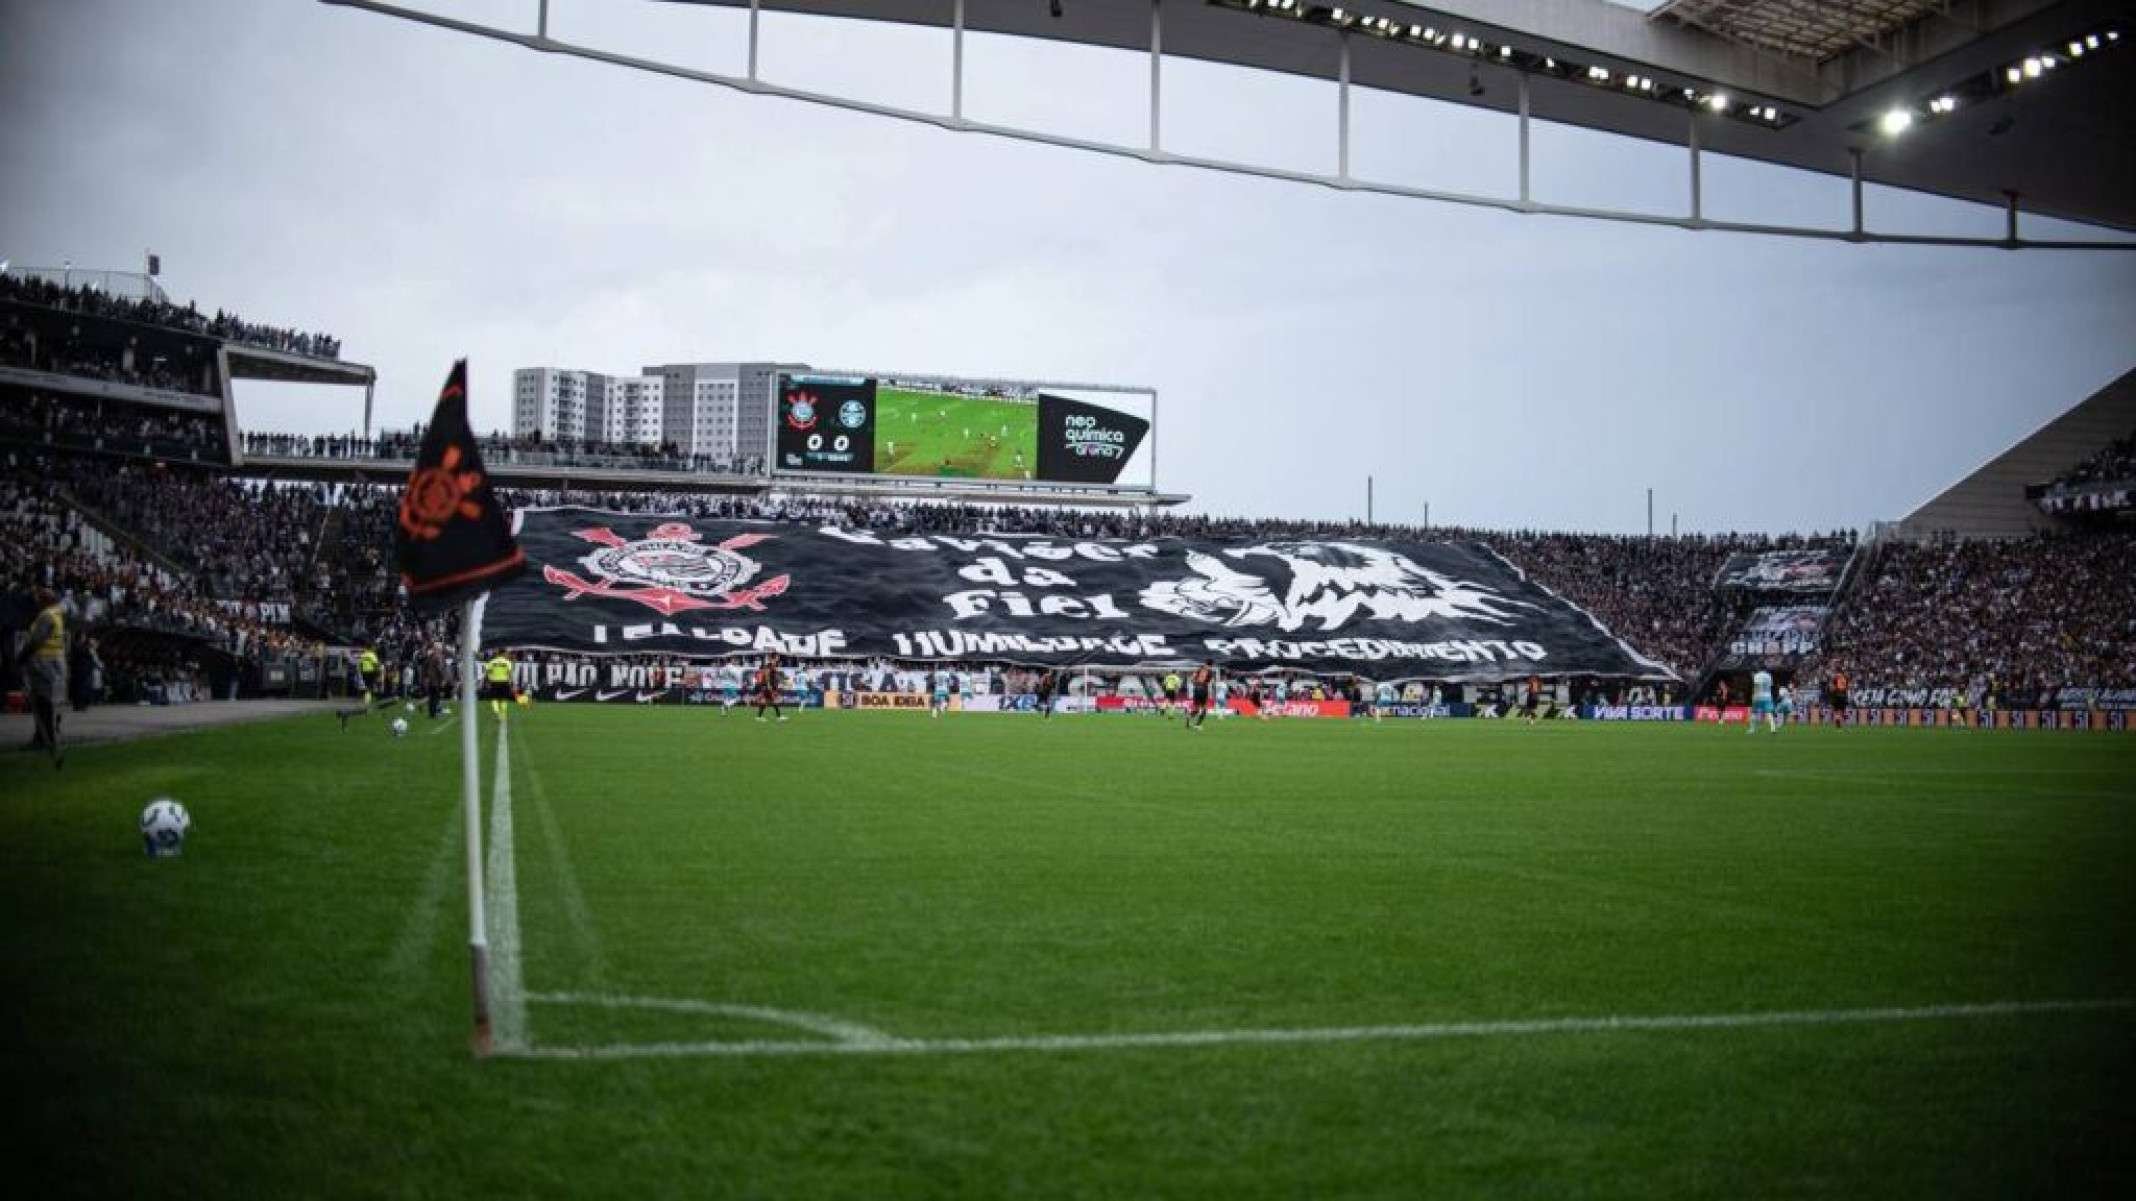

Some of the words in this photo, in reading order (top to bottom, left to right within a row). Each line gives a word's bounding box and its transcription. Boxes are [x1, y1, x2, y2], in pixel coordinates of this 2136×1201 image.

[1065, 416, 1096, 430] neo
[807, 434, 823, 451] 0
[833, 436, 849, 451] 0
[958, 556, 1077, 586] da
[942, 589, 1130, 619] Fiel
[861, 695, 890, 707] BOA
[1593, 706, 1628, 720] VIVA
[1631, 706, 1685, 721] SORTE
